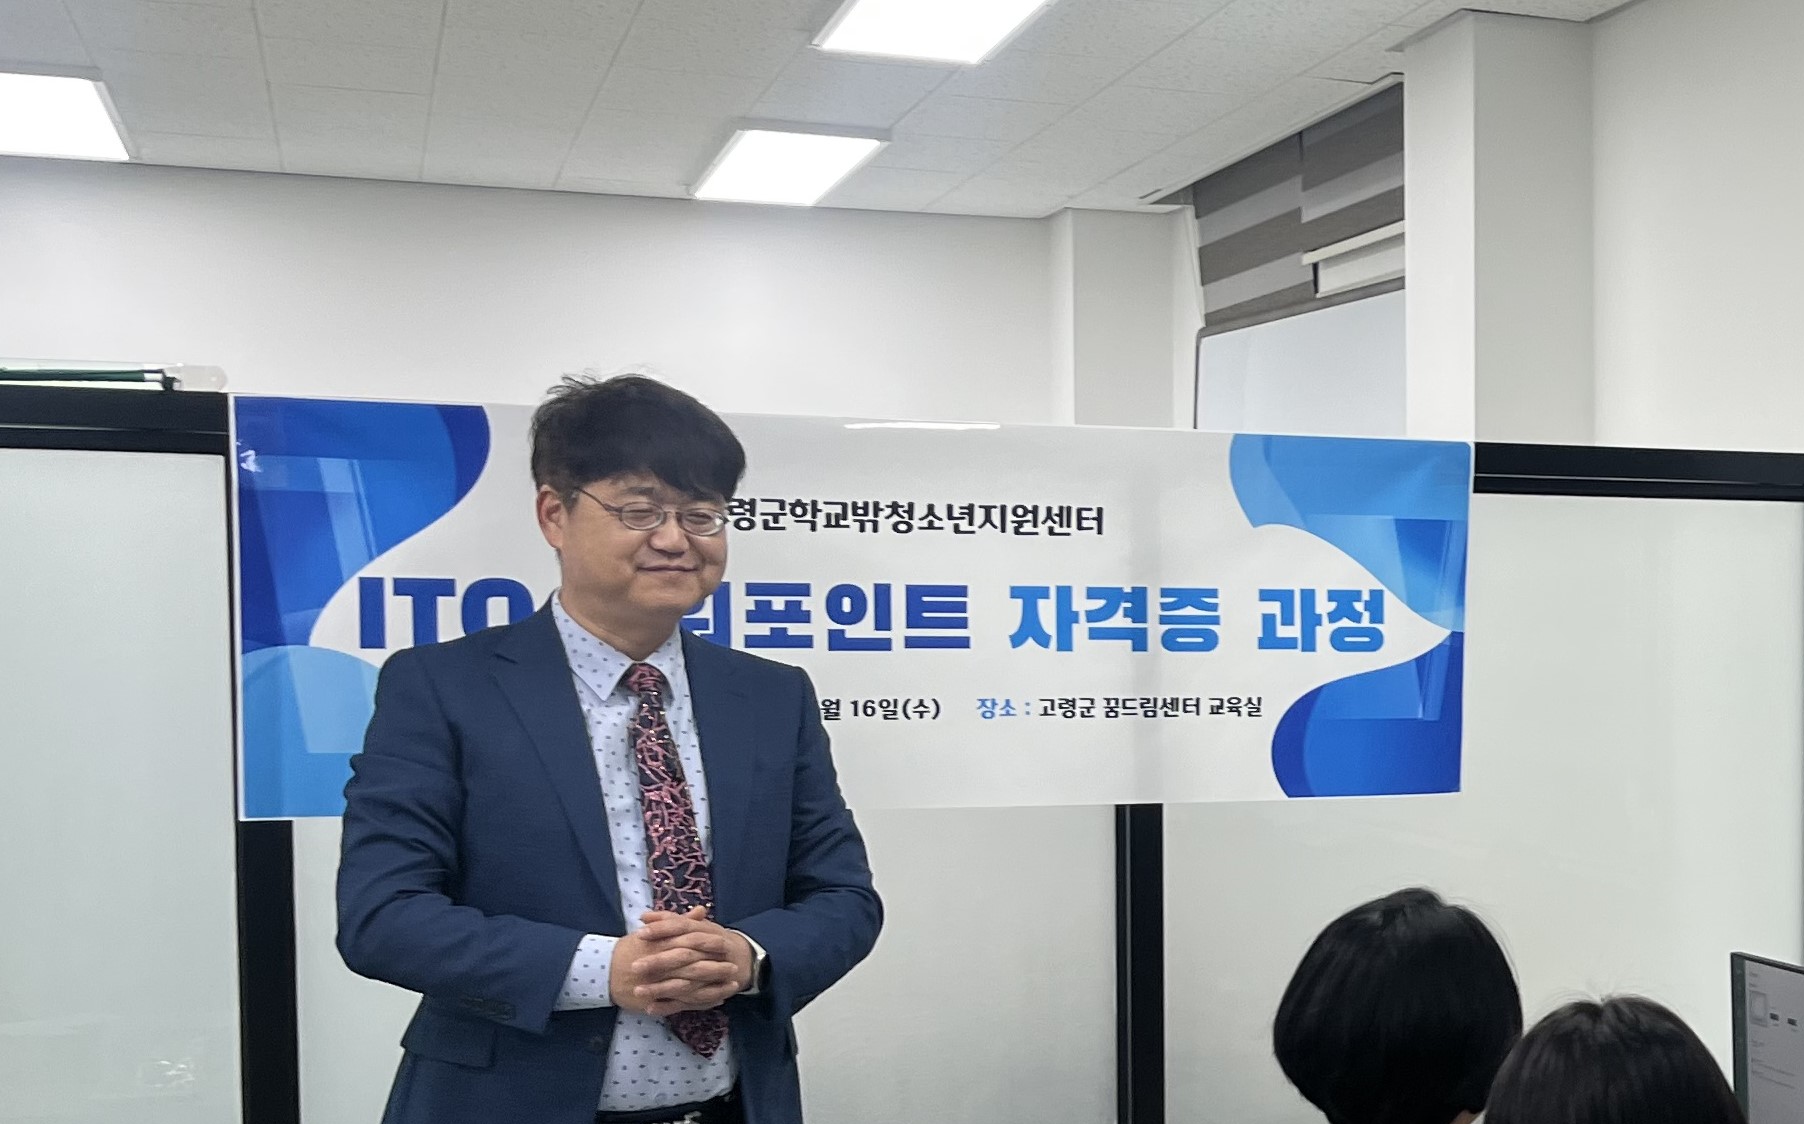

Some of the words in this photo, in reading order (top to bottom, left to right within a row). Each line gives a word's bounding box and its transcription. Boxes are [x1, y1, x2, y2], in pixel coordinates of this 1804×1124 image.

[727, 498, 1104, 536] 령군학교밖청소년지원센터
[1009, 585, 1221, 653] 자격증
[1257, 588, 1385, 653] 과정
[820, 698, 842, 721] 월
[850, 698, 941, 721] 16일(수)
[976, 698, 1017, 720] 장소
[1038, 698, 1096, 720] 고령군
[1102, 696, 1201, 719] 꿈드림센터
[1208, 696, 1263, 718] 교육실
